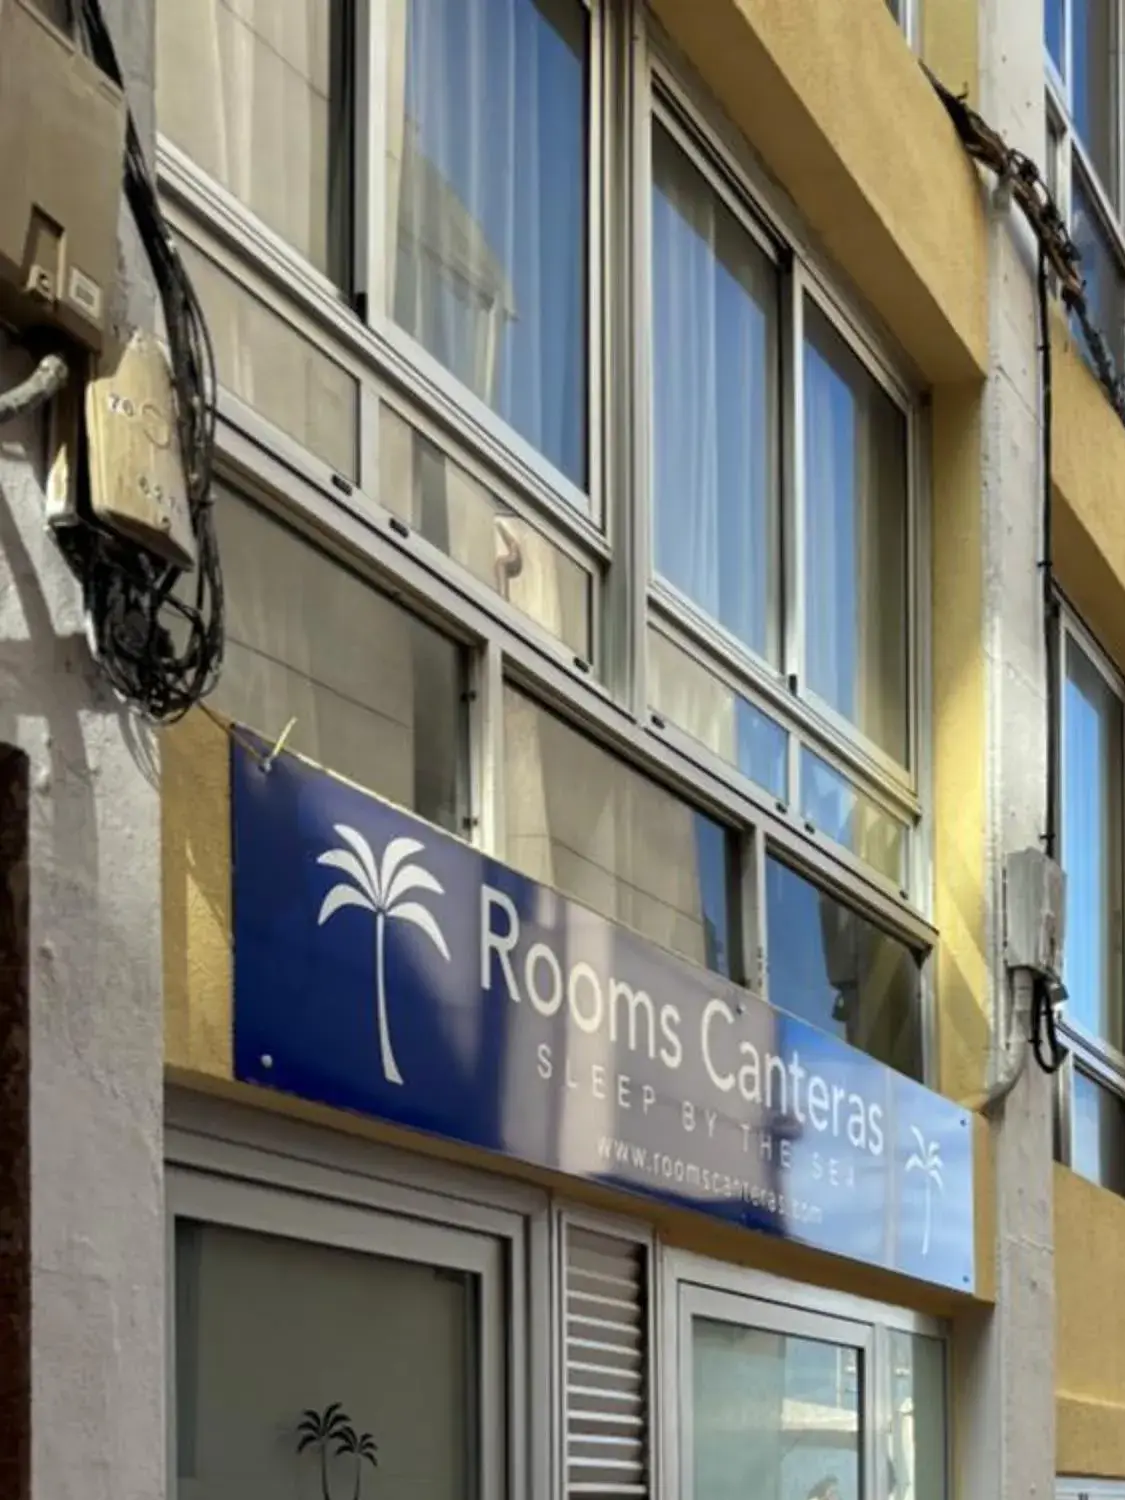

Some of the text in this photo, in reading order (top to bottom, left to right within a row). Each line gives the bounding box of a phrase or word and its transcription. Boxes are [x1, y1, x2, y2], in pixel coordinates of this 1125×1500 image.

[479, 883, 884, 1156] Rooms Canteras
[537, 1043, 657, 1114] SLEEP
[681, 1101, 718, 1138] BY
[741, 1123, 792, 1168] THE
